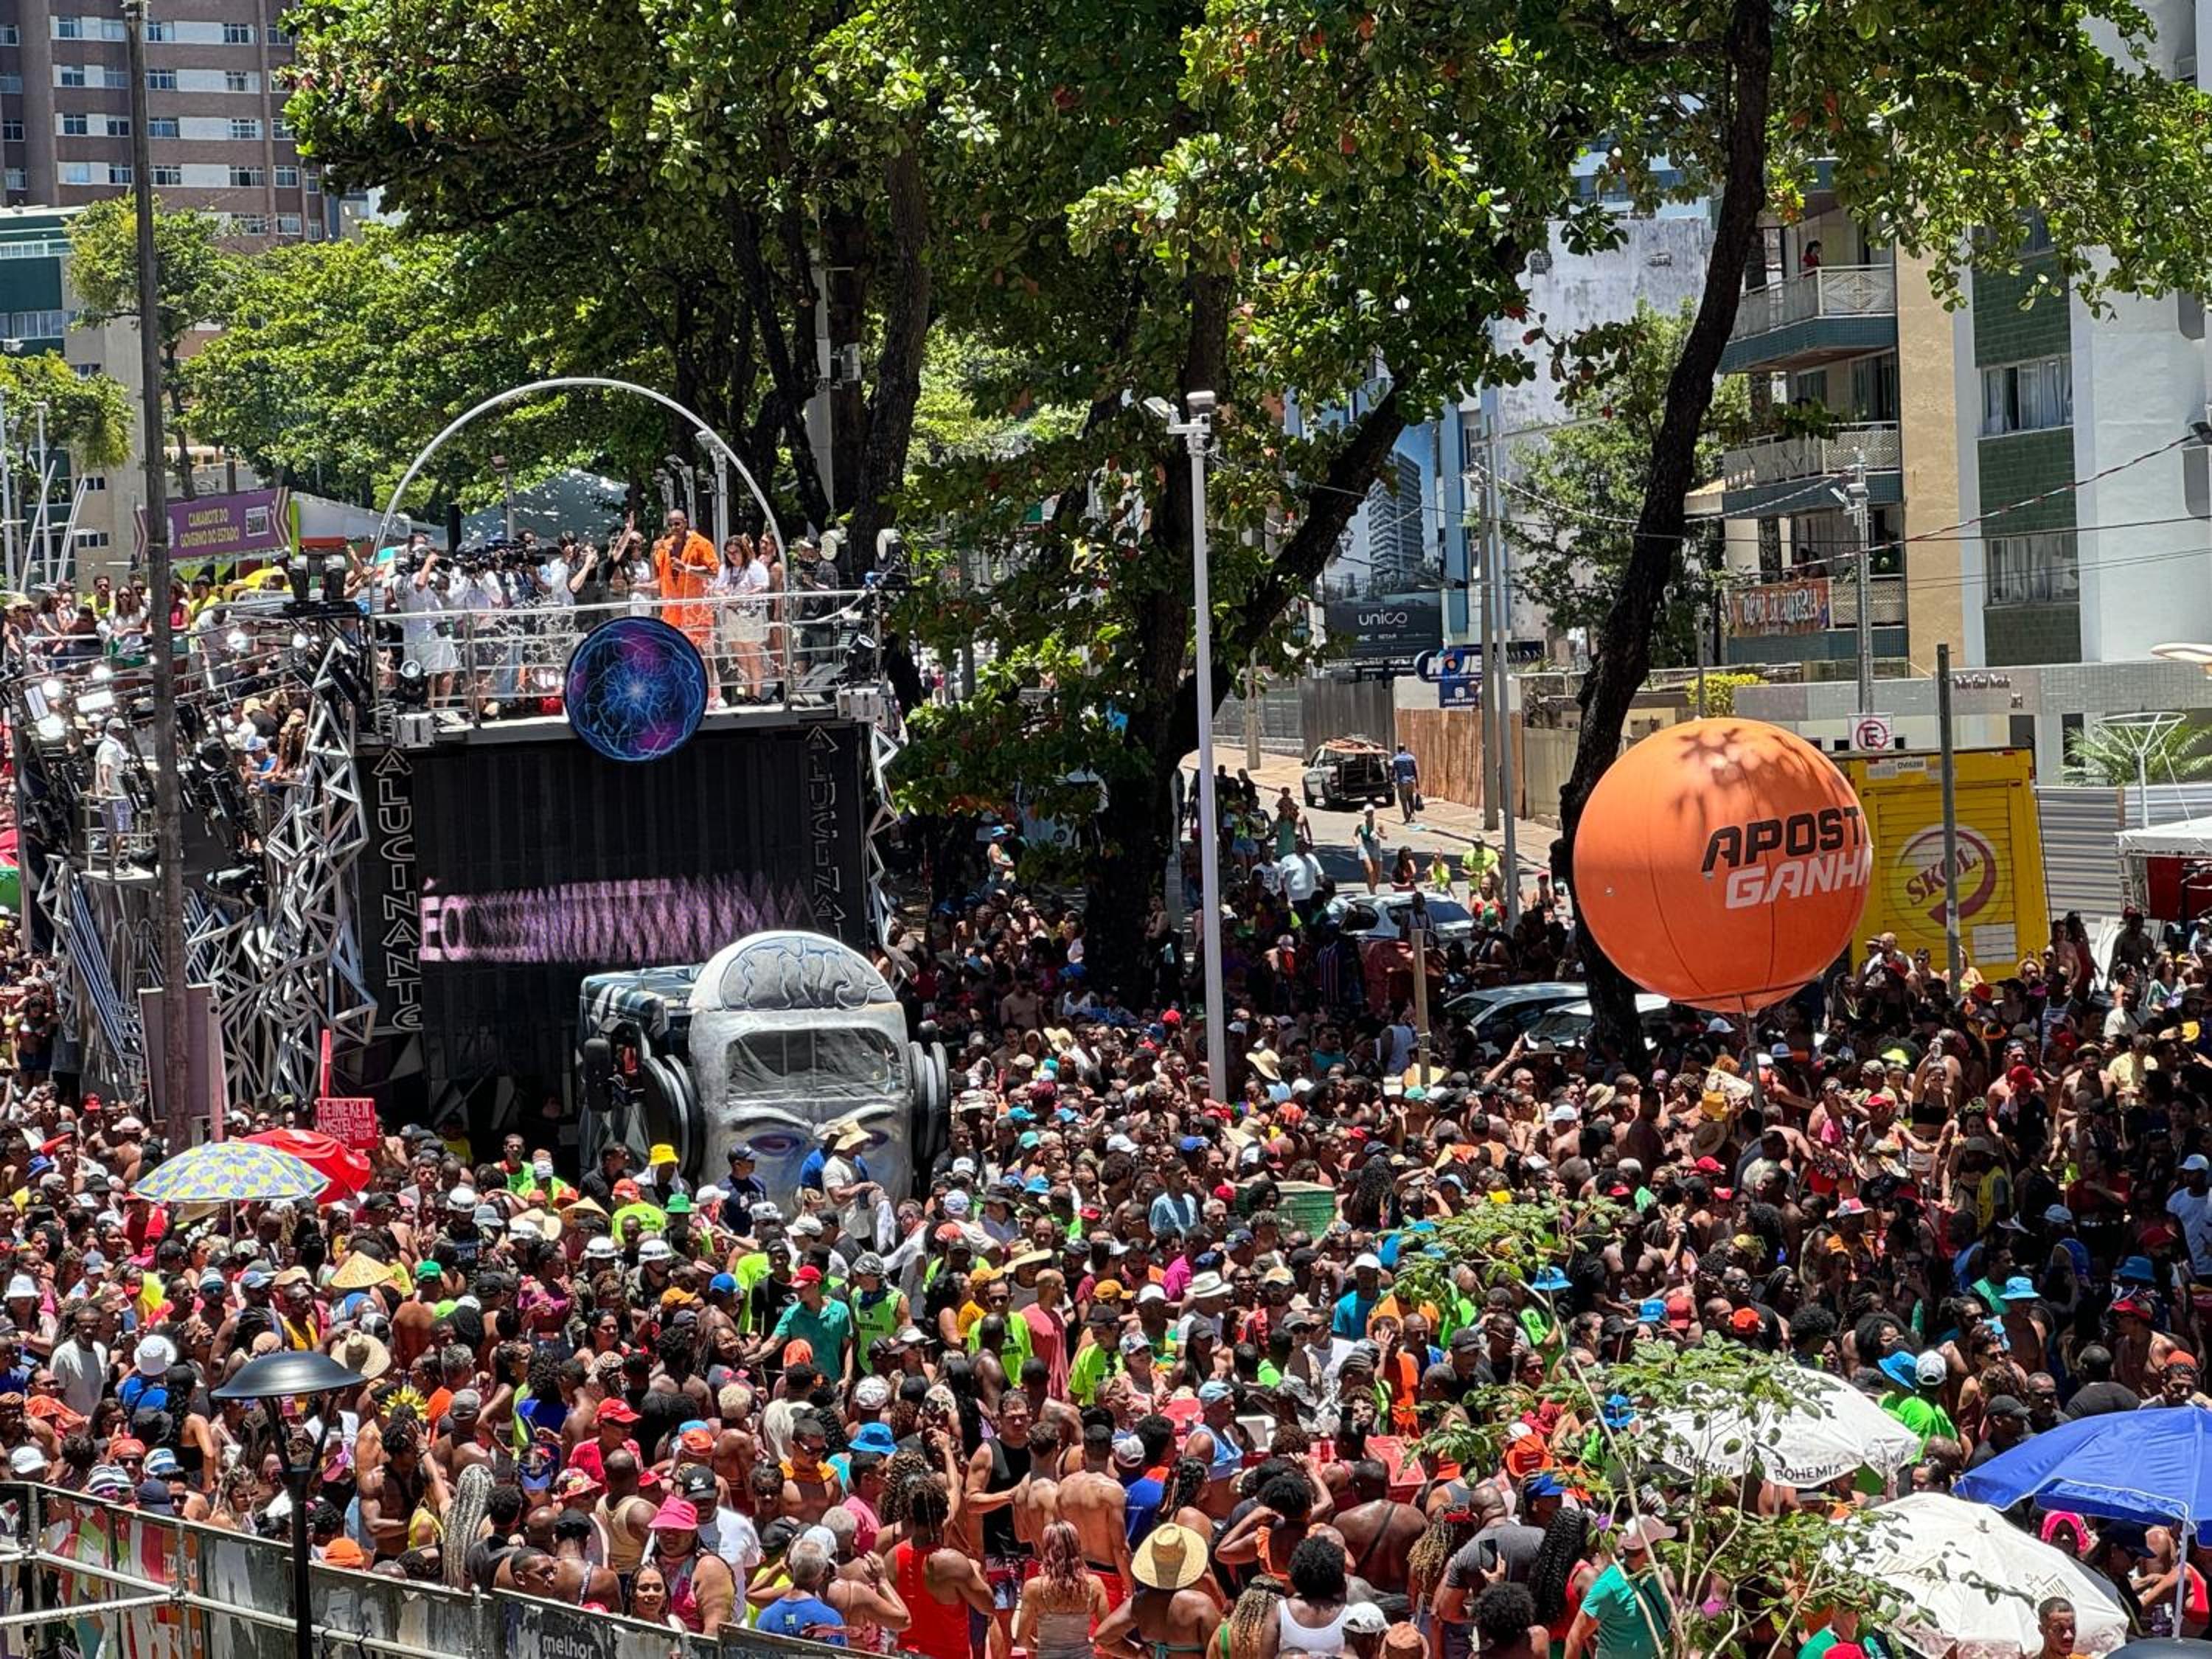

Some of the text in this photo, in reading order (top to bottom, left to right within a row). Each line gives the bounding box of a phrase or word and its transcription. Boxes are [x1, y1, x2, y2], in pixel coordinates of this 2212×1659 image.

[1865, 726, 1878, 747] E
[1701, 805, 1869, 874] APOST
[372, 747, 424, 1031] ALUCINANTE
[318, 1100, 369, 1119] HEINEKEN
[317, 1117, 354, 1133] AMSTEL
[1773, 1464, 1843, 1482] BOHEMIA
[542, 1635, 594, 1658] melhor
